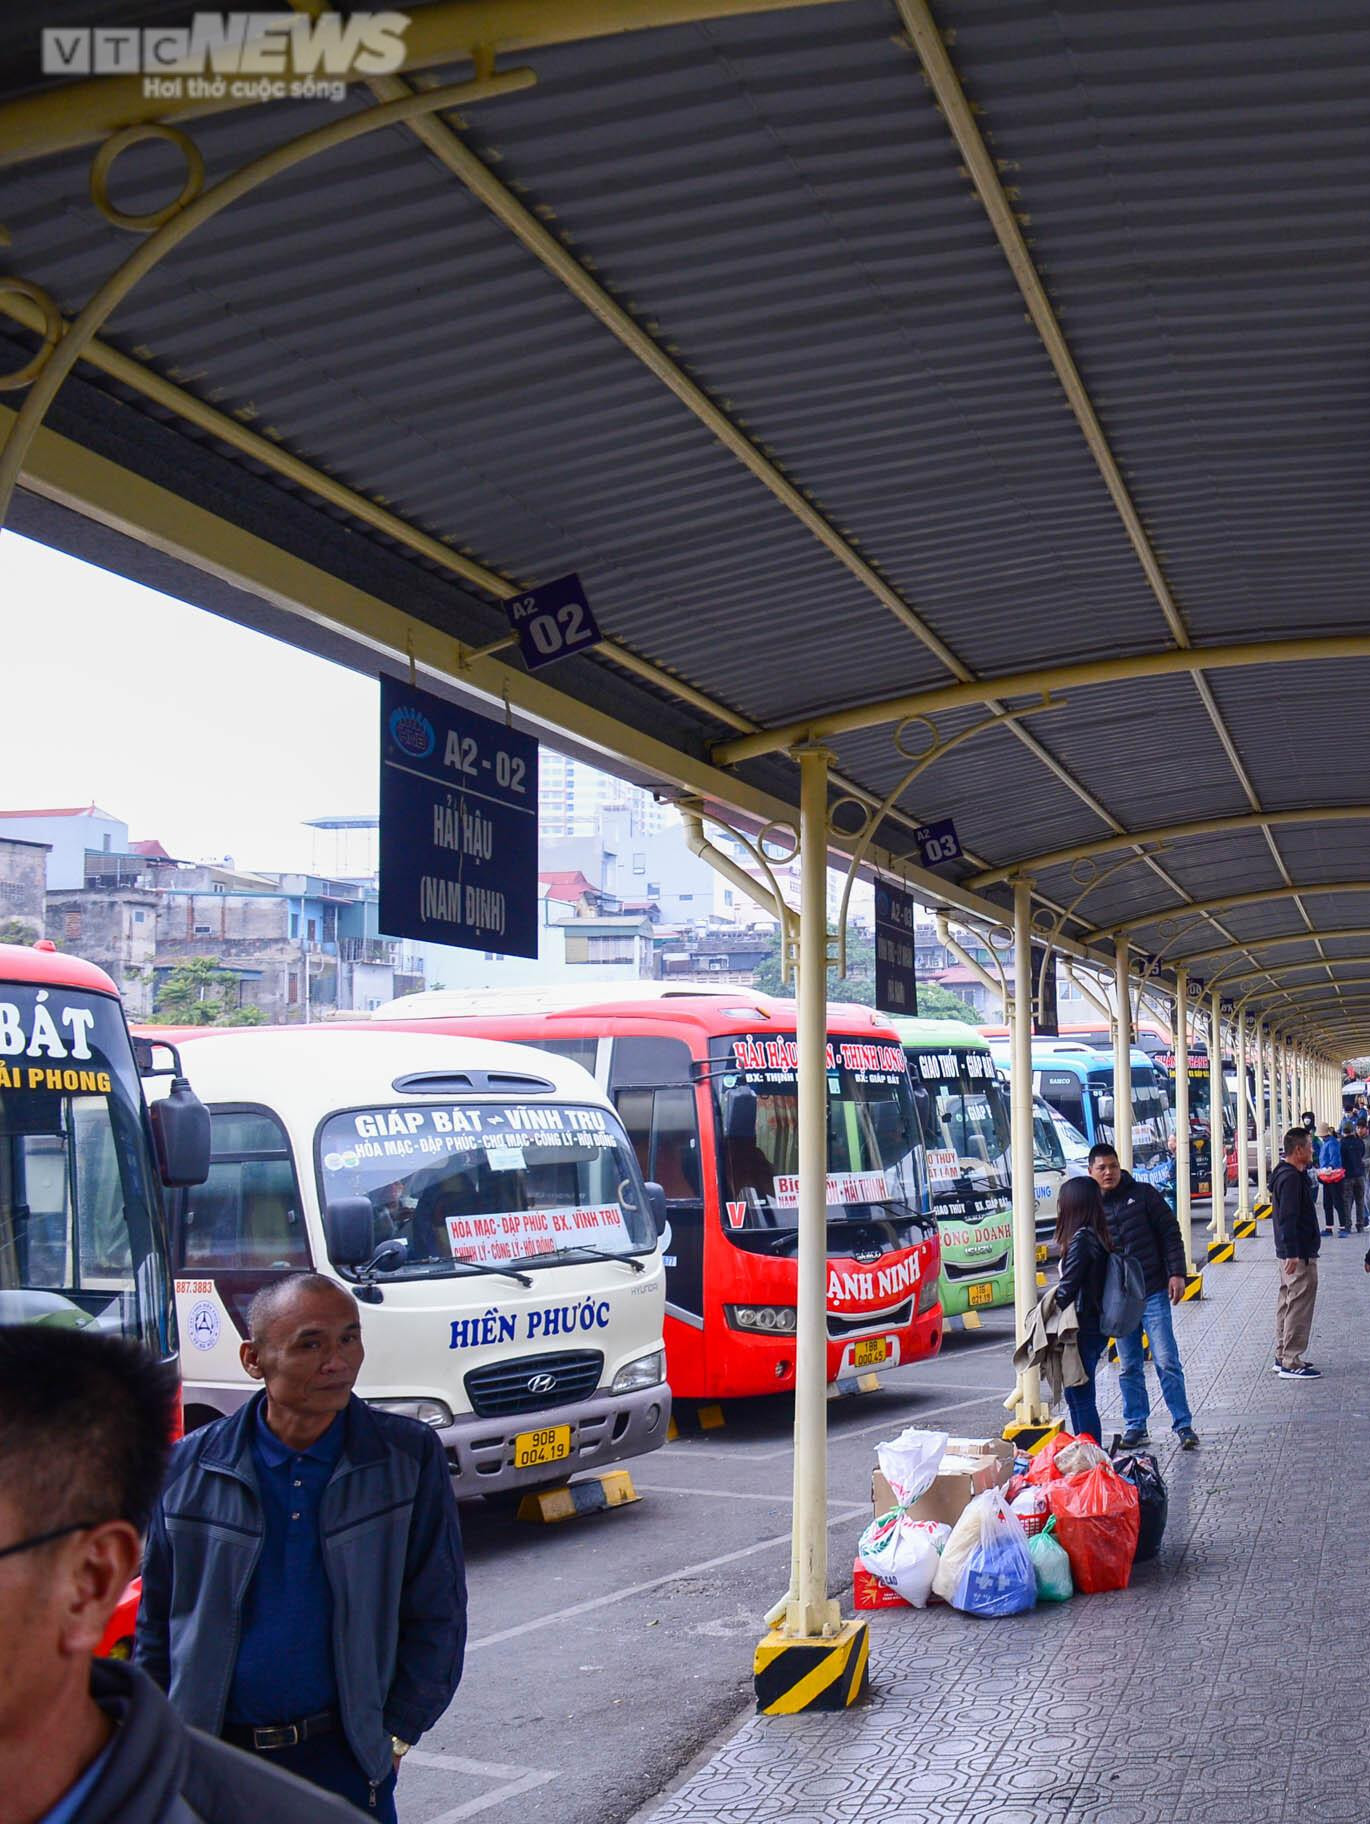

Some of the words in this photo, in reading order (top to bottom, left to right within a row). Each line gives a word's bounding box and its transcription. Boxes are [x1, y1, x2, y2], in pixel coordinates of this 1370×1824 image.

[512, 598, 538, 620] A2
[529, 602, 593, 655] 02
[433, 794, 459, 849] HẢI
[463, 808, 493, 865] HẬU
[925, 835, 957, 861] 03
[0, 989, 95, 1060] BÁT
[733, 1034, 767, 1069] HẢI
[766, 1035, 798, 1072] HẬU
[840, 1043, 881, 1074] THỊNH
[919, 1055, 940, 1079] GIAO
[355, 1108, 426, 1138] GIÁP
[434, 1107, 480, 1133] BÁT
[505, 1106, 560, 1131] VĨNH
[564, 1110, 606, 1133] TRỤ
[355, 1139, 383, 1158] HÒA
[384, 1140, 413, 1158] MẠC
[446, 1132, 477, 1152] PHÚC
[451, 1217, 472, 1239] HÒA
[473, 1218, 496, 1239] MẠC
[522, 1211, 548, 1232] PHÚC
[572, 1209, 599, 1229] VĨNH
[599, 1208, 621, 1228] TRỤ
[941, 1227, 969, 1247] ÔNG
[975, 1223, 1012, 1243] DOANH
[827, 1270, 878, 1306] ẠNH
[878, 1253, 921, 1298] NINH
[448, 1306, 518, 1349] HIỀN
[526, 1295, 611, 1340] PHƯỚC
[532, 1430, 556, 1448] 90B
[521, 1444, 565, 1467] 004.19
